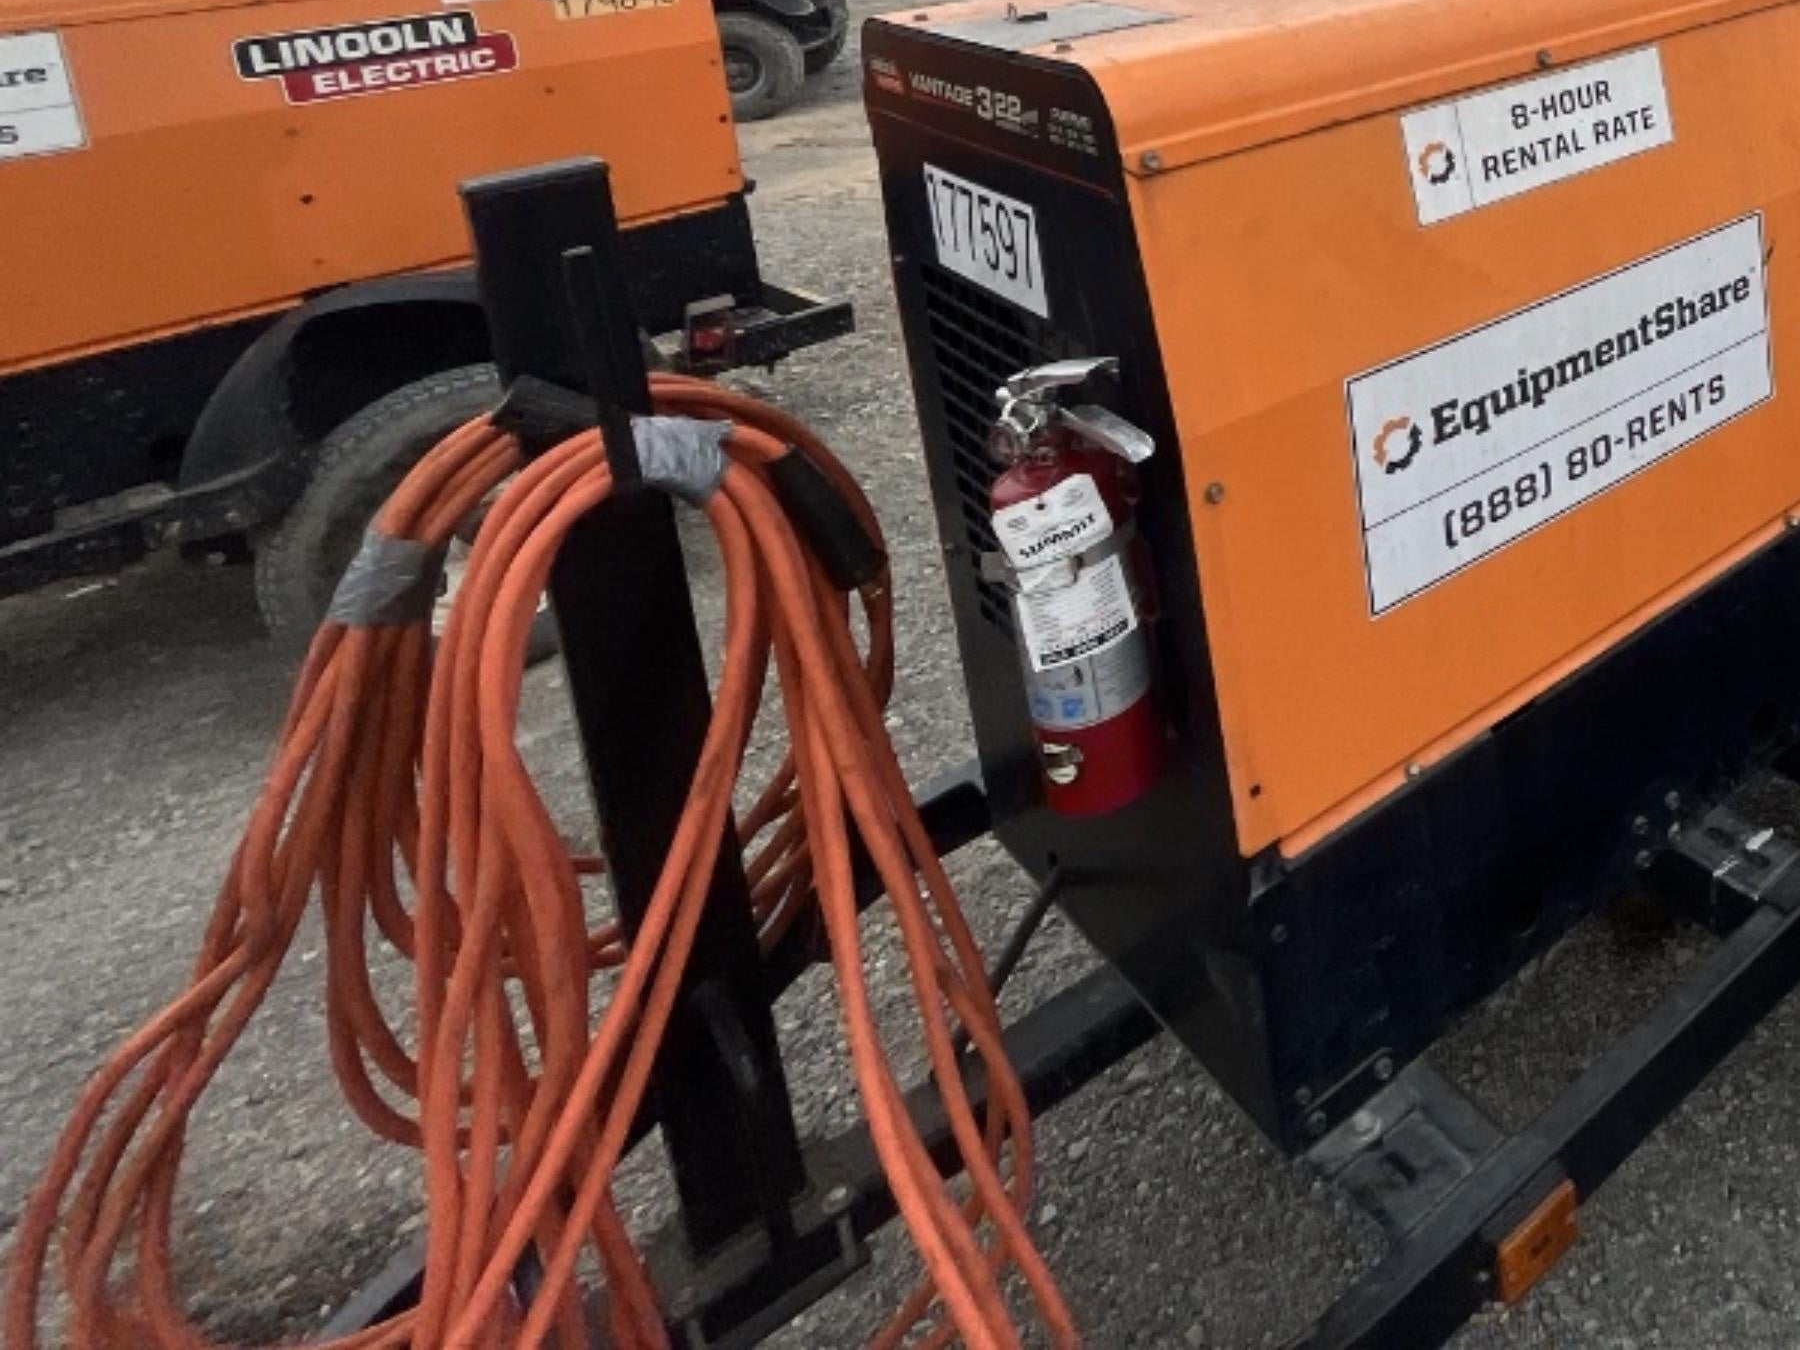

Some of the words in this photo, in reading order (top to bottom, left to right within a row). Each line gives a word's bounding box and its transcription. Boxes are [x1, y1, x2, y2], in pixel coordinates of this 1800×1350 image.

[248, 16, 467, 74] LINCOLN
[312, 48, 498, 95] ELECTRIC
[908, 70, 974, 107] VANTAGE
[1511, 80, 1612, 130] 8-HOUR
[1482, 124, 1587, 183] RENTAL
[1593, 106, 1658, 144] RATE
[928, 175, 1034, 289] 177597
[1431, 273, 1752, 446] EquipmentShare
[1444, 465, 1554, 549] (888)
[1566, 373, 1728, 482] 80-RENTS
